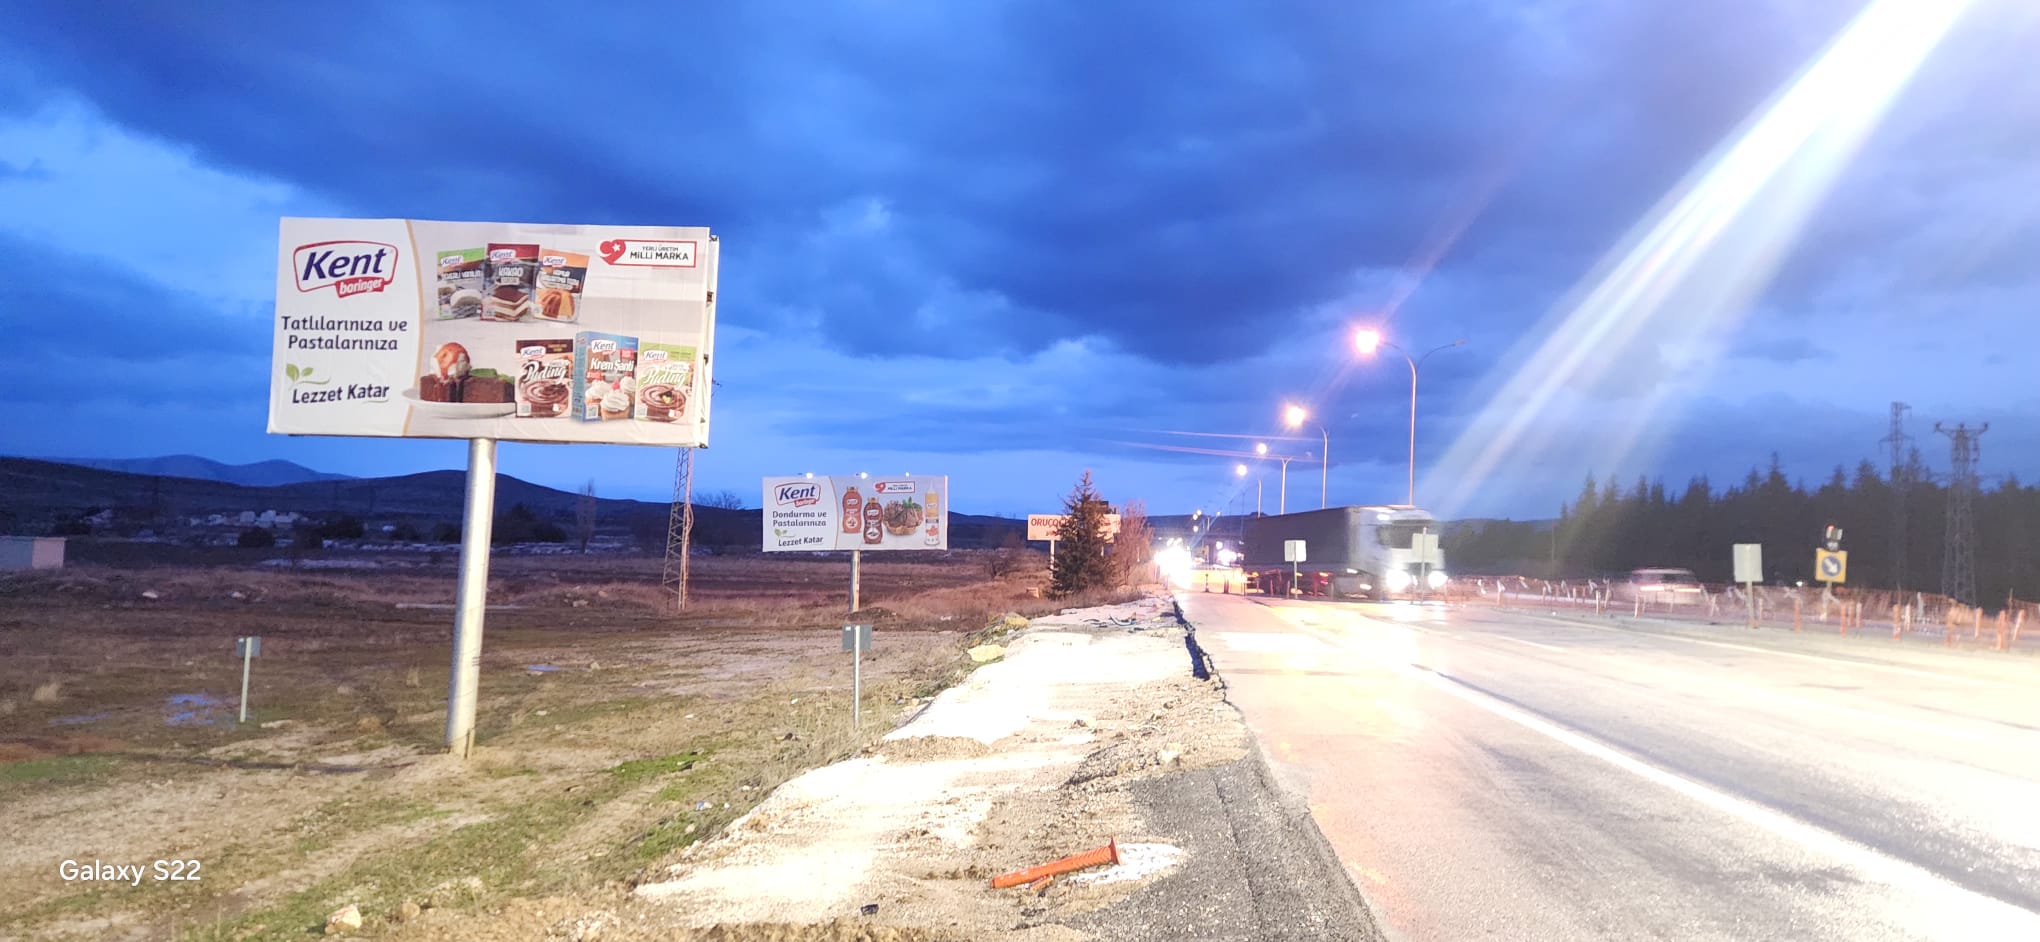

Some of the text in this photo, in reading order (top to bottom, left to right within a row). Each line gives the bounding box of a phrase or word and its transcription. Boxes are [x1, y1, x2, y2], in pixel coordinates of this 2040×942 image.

[655, 252, 689, 260] MARKA
[302, 248, 387, 281] Kent
[340, 279, 383, 296] boringer
[281, 315, 408, 332] Tatlılarınıza ve
[288, 334, 399, 351] Pastalarınıza
[592, 341, 615, 350] Kent
[590, 358, 614, 371] Krem
[292, 383, 390, 404] Lezzet Katar
[779, 486, 815, 501] Kent
[772, 510, 815, 519] Dondurma
[778, 536, 824, 547] Lezzet Katar
